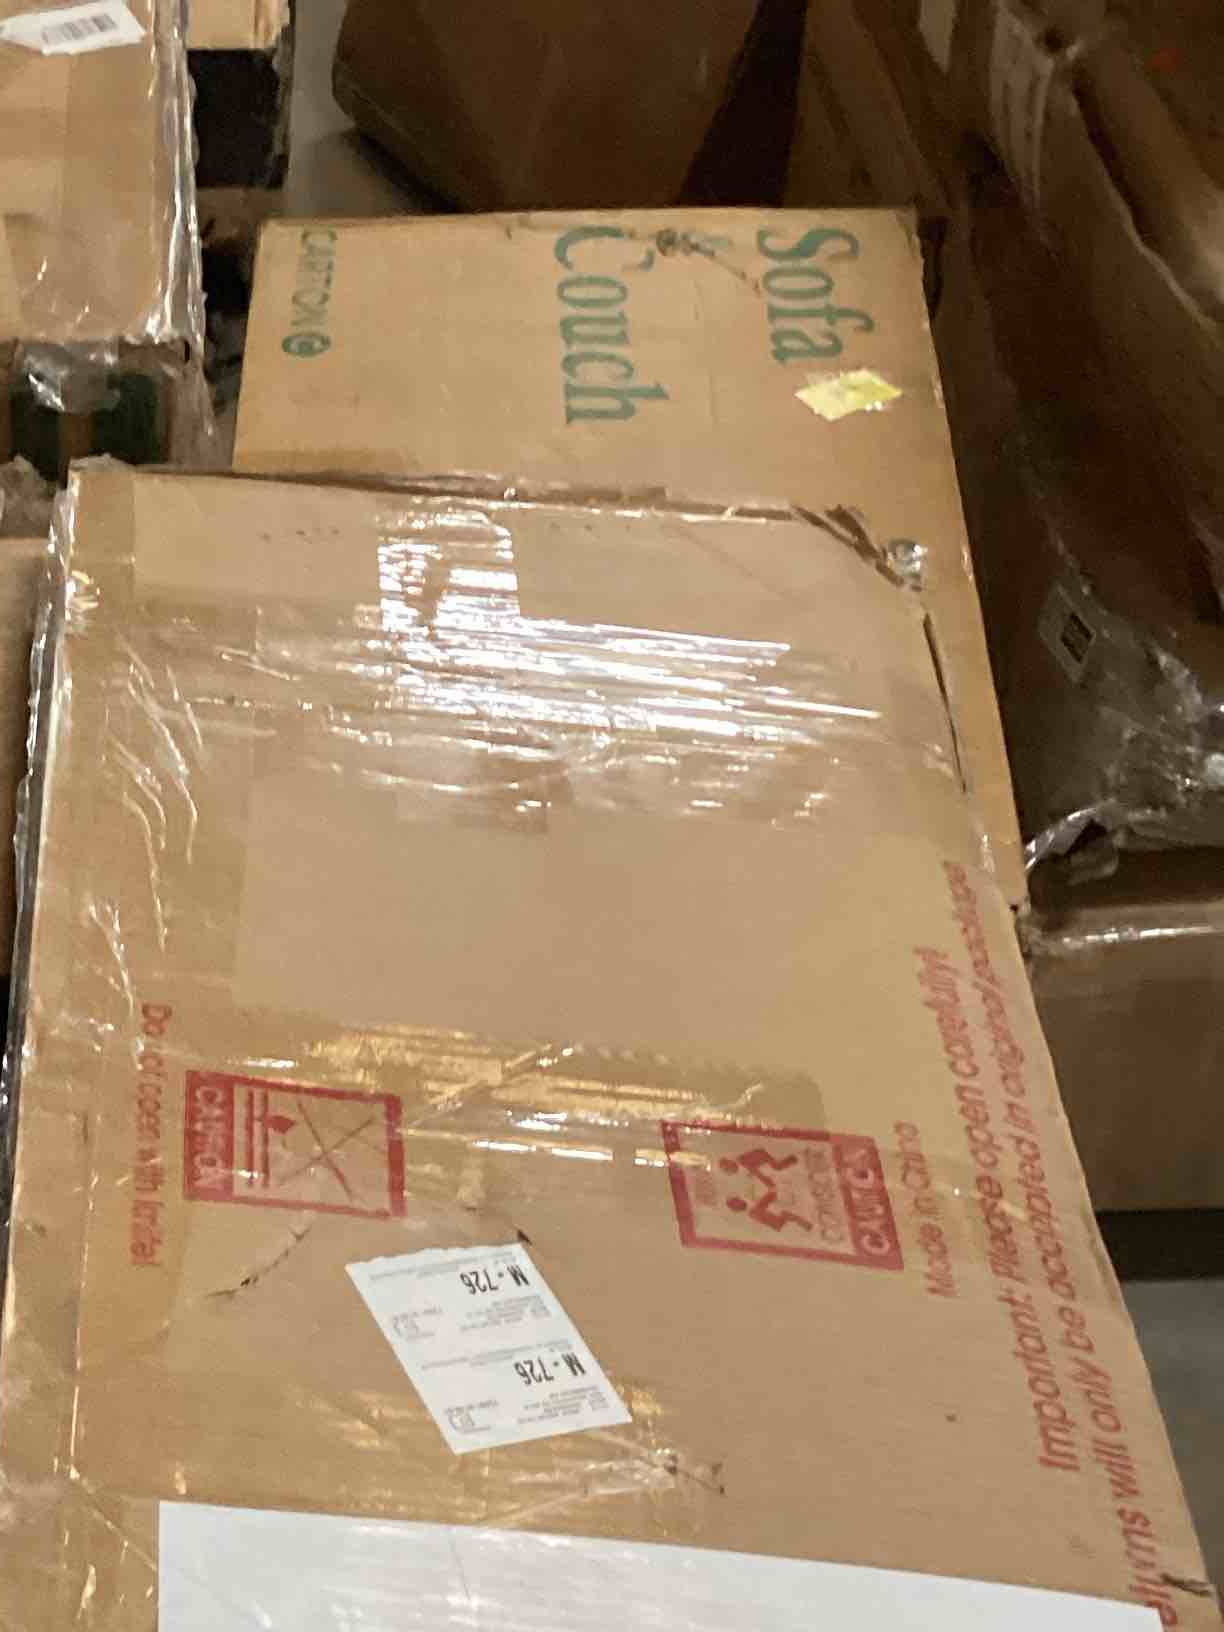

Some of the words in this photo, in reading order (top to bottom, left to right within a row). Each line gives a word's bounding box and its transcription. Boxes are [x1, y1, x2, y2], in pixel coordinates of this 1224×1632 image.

[552, 225, 670, 424] Couch
[757, 227, 874, 364] Sofa
[142, 1003, 172, 1036] Do
[953, 1084, 1002, 1168] open
[1004, 1100, 1034, 1135] in
[909, 1197, 943, 1219] in
[974, 1175, 1023, 1284] Please
[1007, 1138, 1078, 1303] accepted
[918, 1223, 959, 1297] Made
[1054, 1307, 1095, 1353] be
[997, 1288, 1081, 1472] Important:
[1071, 1356, 1125, 1433] only
[1089, 1439, 1140, 1500] will
